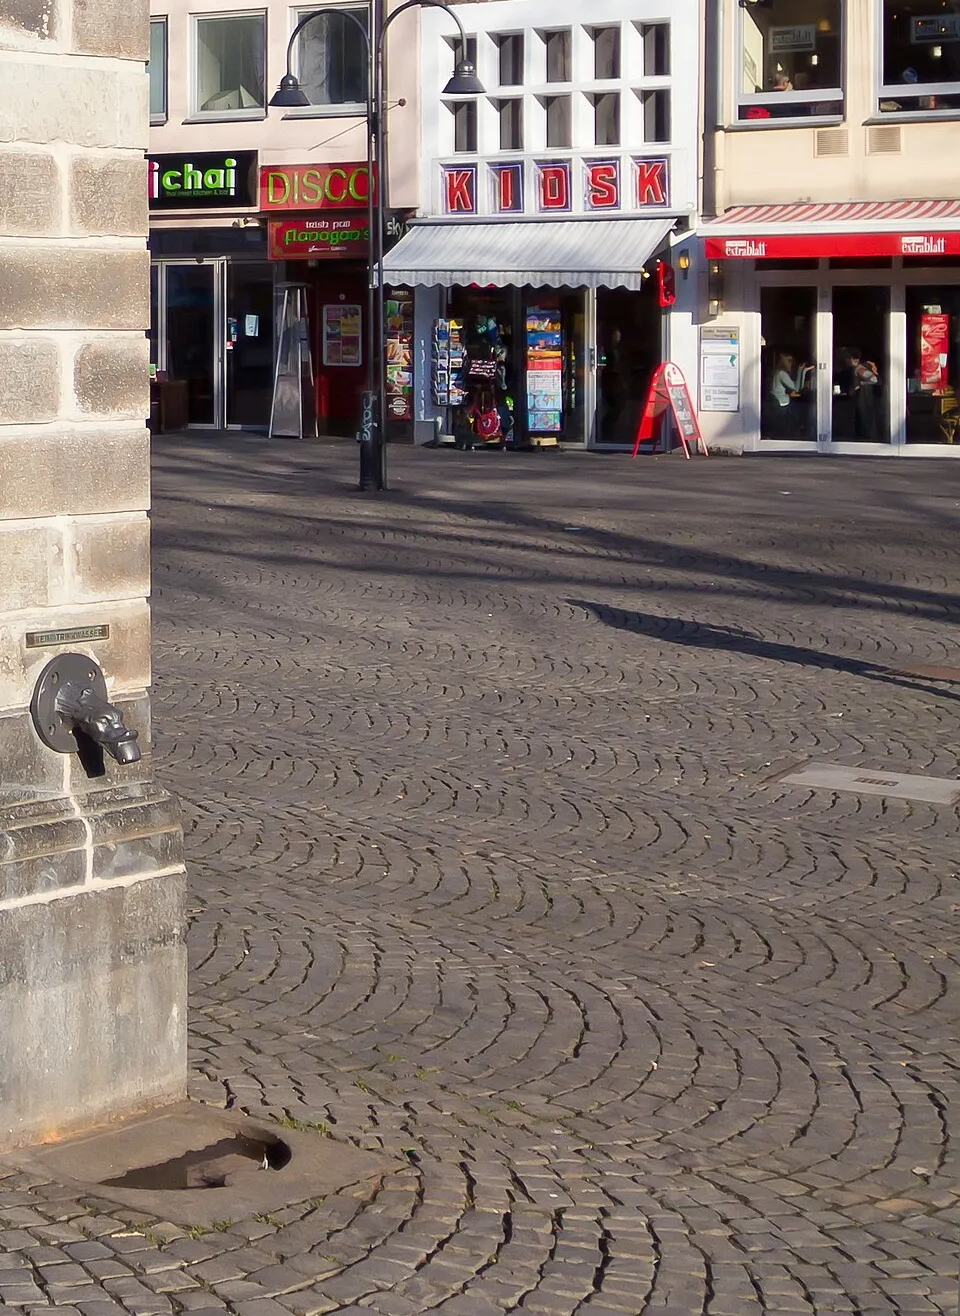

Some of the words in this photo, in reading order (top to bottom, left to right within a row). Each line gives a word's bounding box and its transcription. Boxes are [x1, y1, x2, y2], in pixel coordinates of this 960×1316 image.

[268, 168, 375, 204] DISCO
[447, 162, 665, 211] KIOSK
[387, 217, 404, 240] sky
[725, 241, 766, 256] extrablatt
[902, 237, 945, 253] extrablatt
